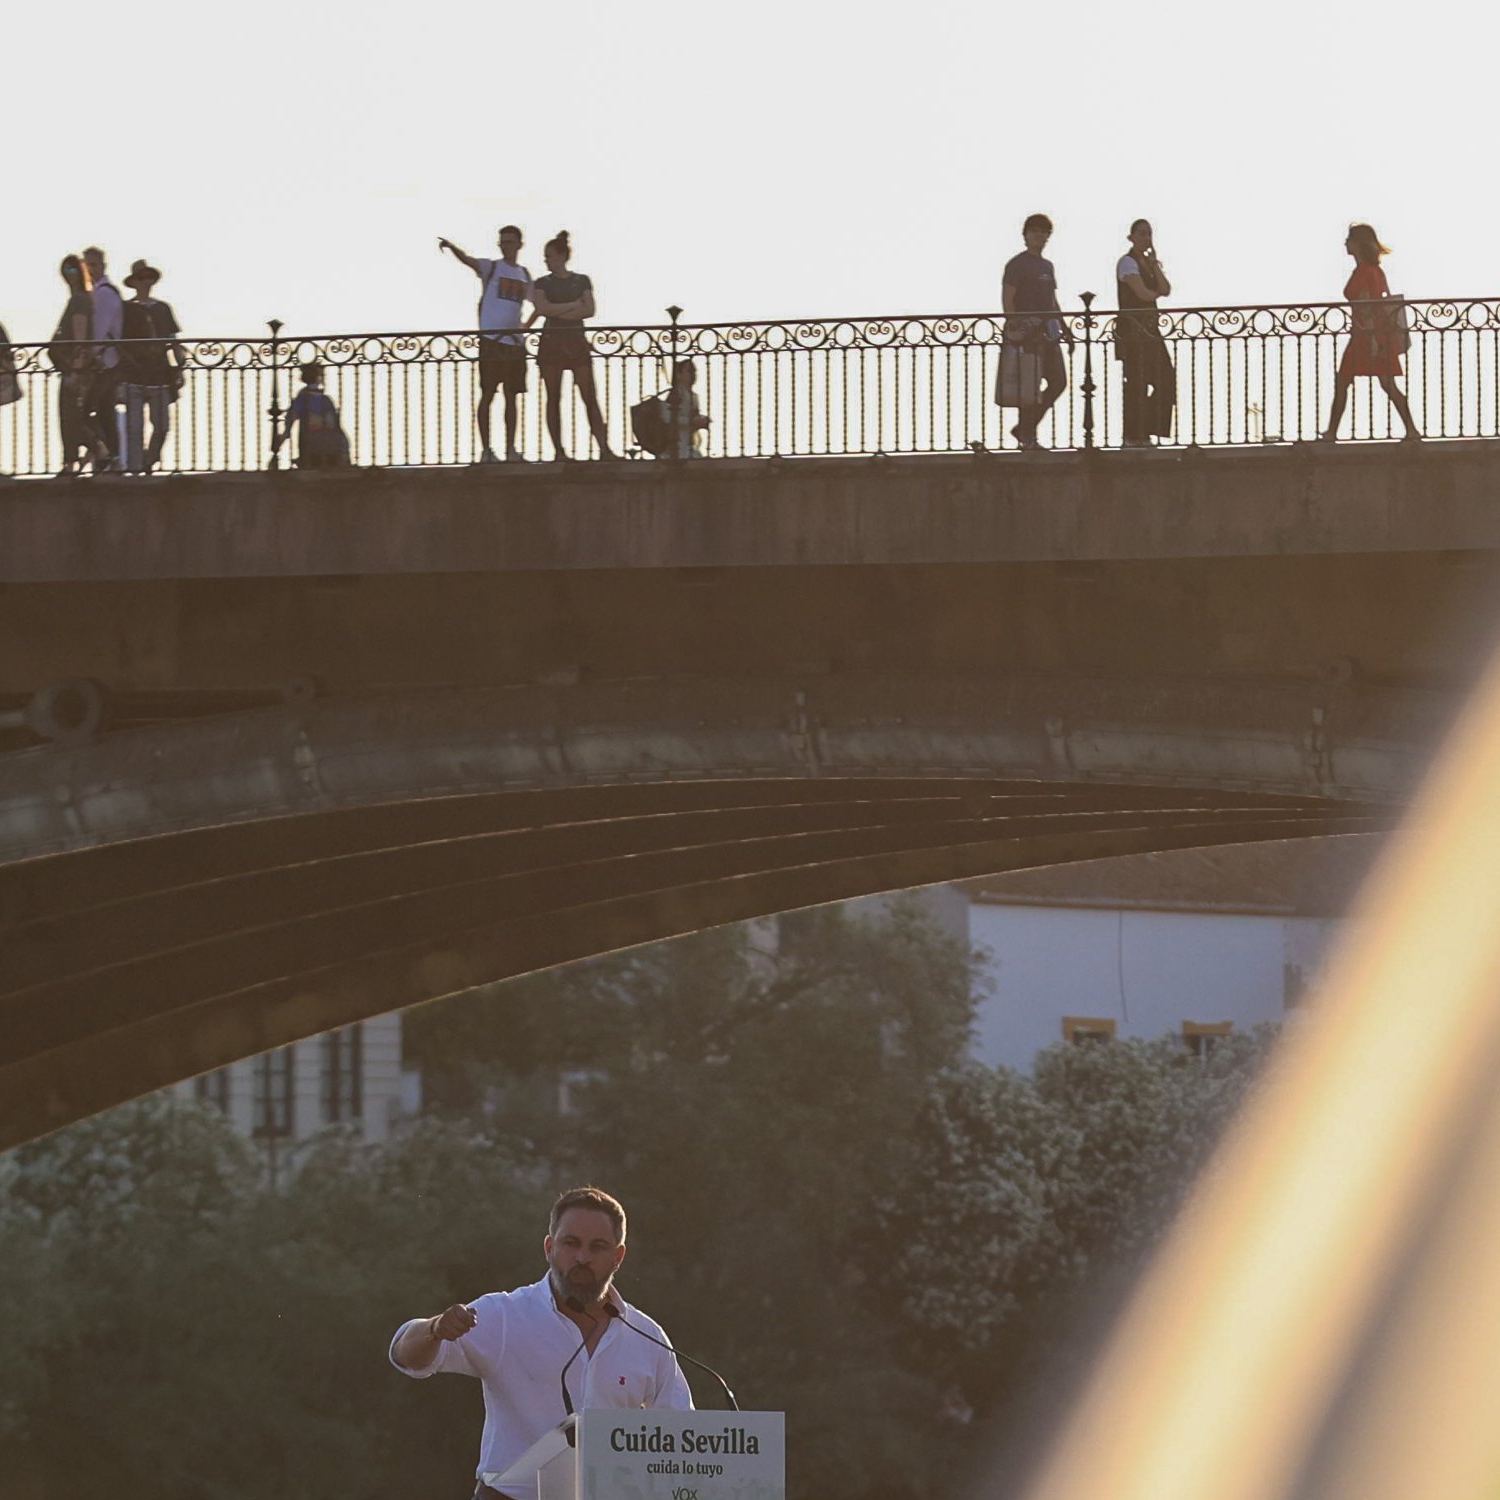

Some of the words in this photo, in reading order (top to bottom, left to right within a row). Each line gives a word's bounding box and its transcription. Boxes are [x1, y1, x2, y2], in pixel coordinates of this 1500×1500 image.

[610, 1425, 675, 1453] Cuida
[681, 1427, 760, 1455] Sevilla
[647, 1460, 680, 1474] cuida
[682, 1460, 694, 1475] lo
[696, 1462, 723, 1478] tuyo
